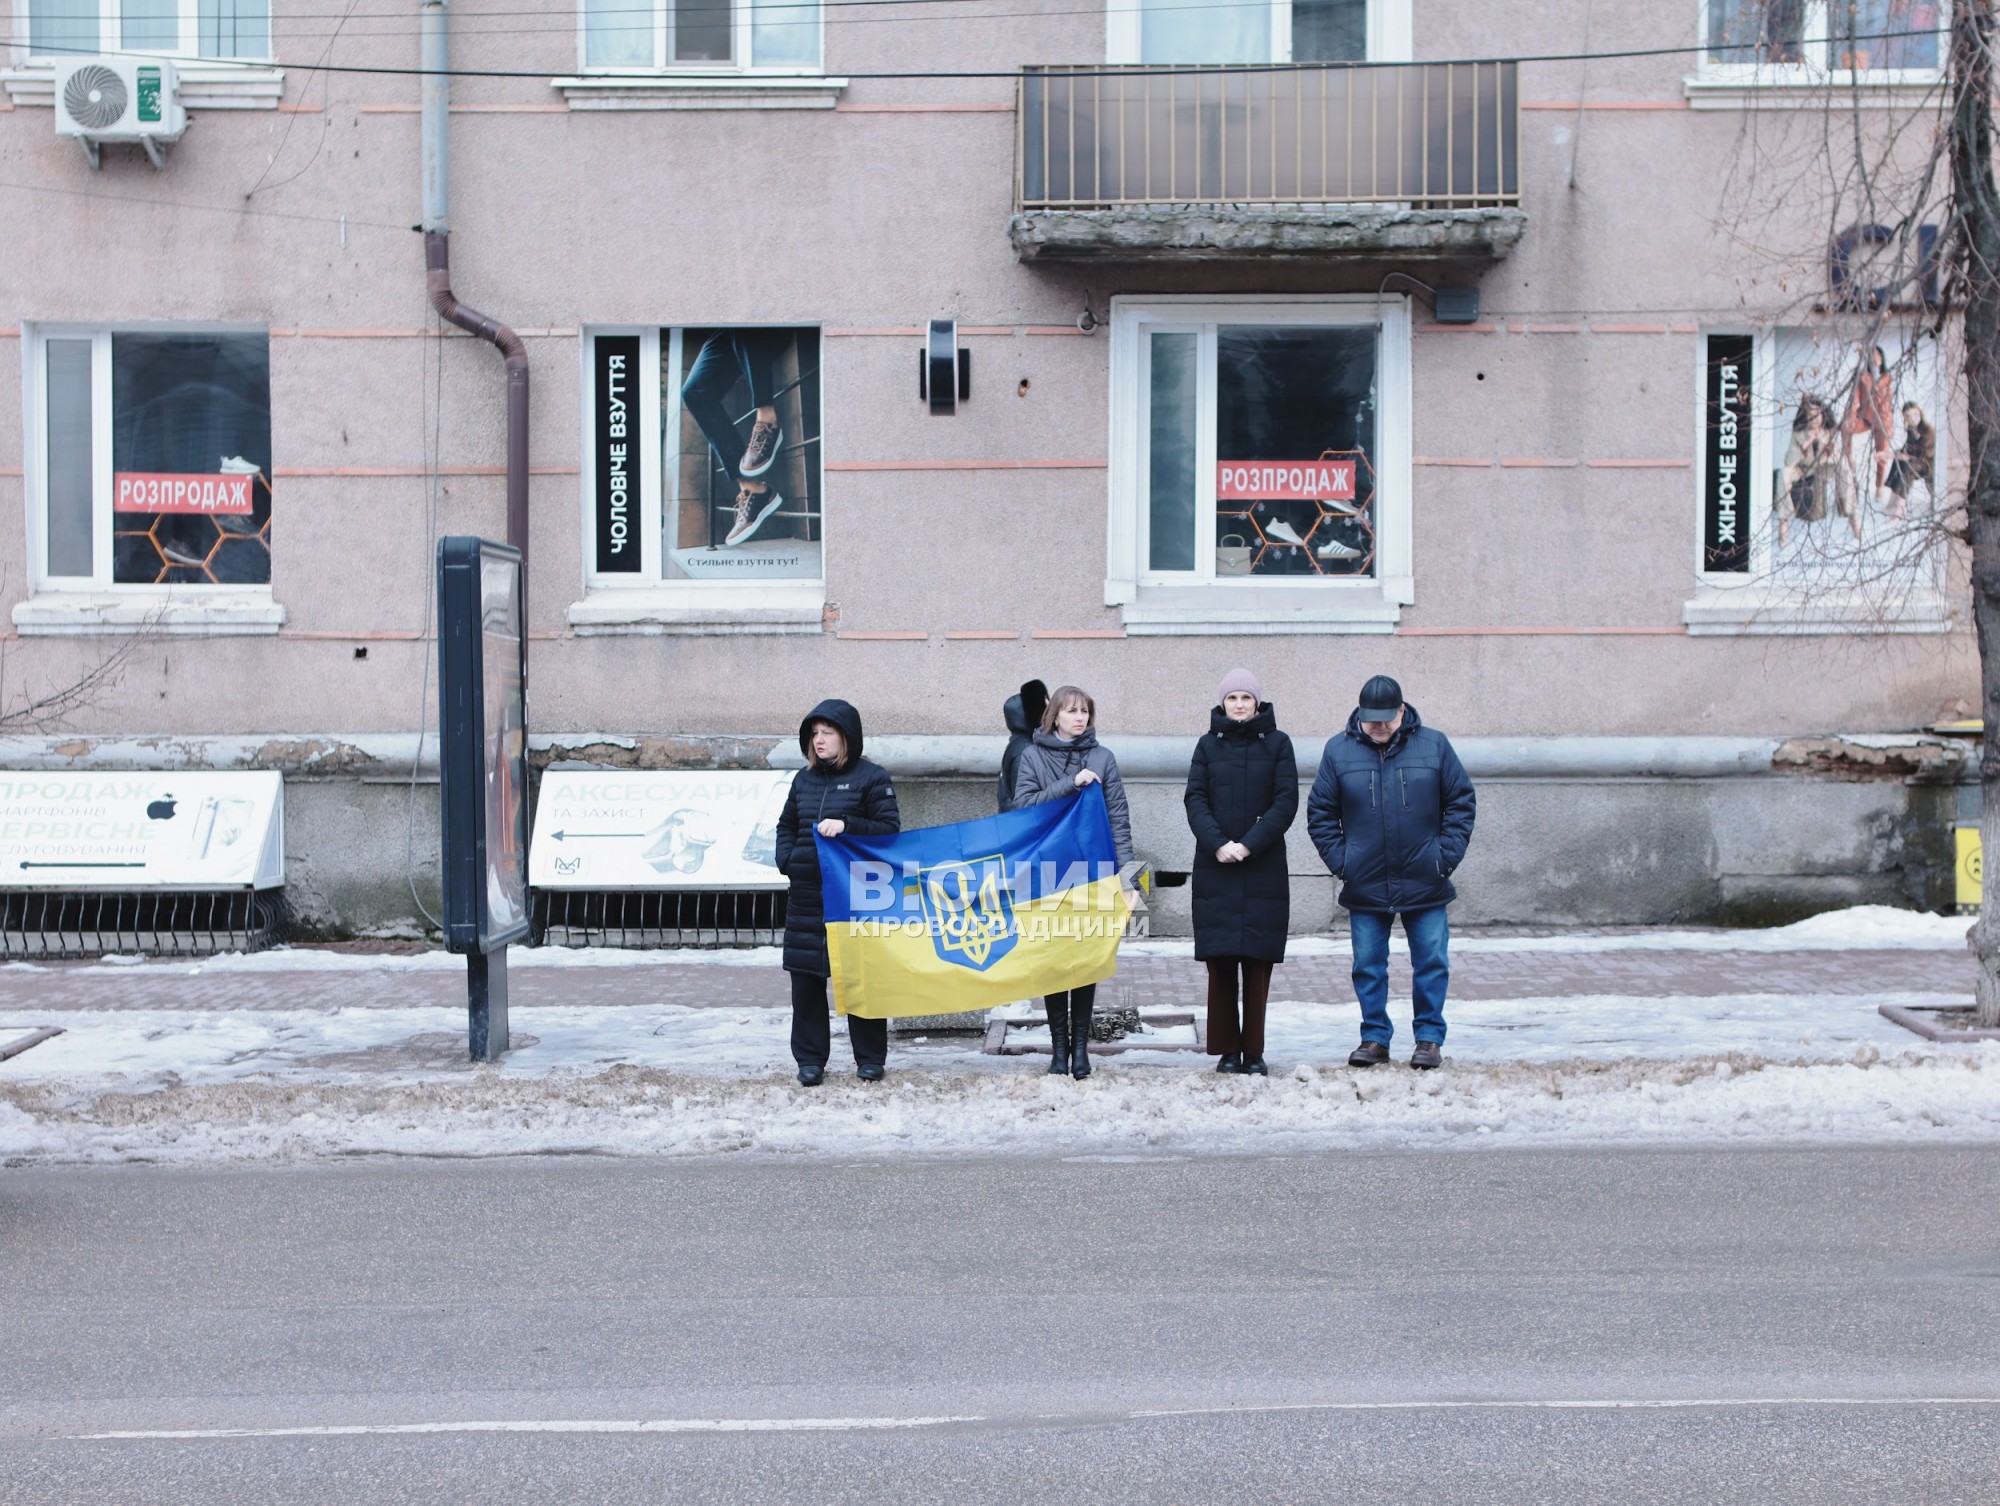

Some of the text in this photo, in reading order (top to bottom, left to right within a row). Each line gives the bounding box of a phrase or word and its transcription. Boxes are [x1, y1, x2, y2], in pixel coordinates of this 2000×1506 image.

[609, 355, 628, 554] ЧОЛОВІЧЕ ВЗУТТЯ
[1718, 365, 1738, 543] ЖІНОЧЕ ВЗУТТЯ
[120, 479, 246, 510] РОЗПРОДАЖ
[1221, 468, 1349, 496] РОЗПРОДАЖ
[687, 557, 799, 568] Стильне взуття тут!
[551, 783, 760, 801] АКСЕСУАРИ
[551, 808, 647, 818] ТА ЗАХИСТ
